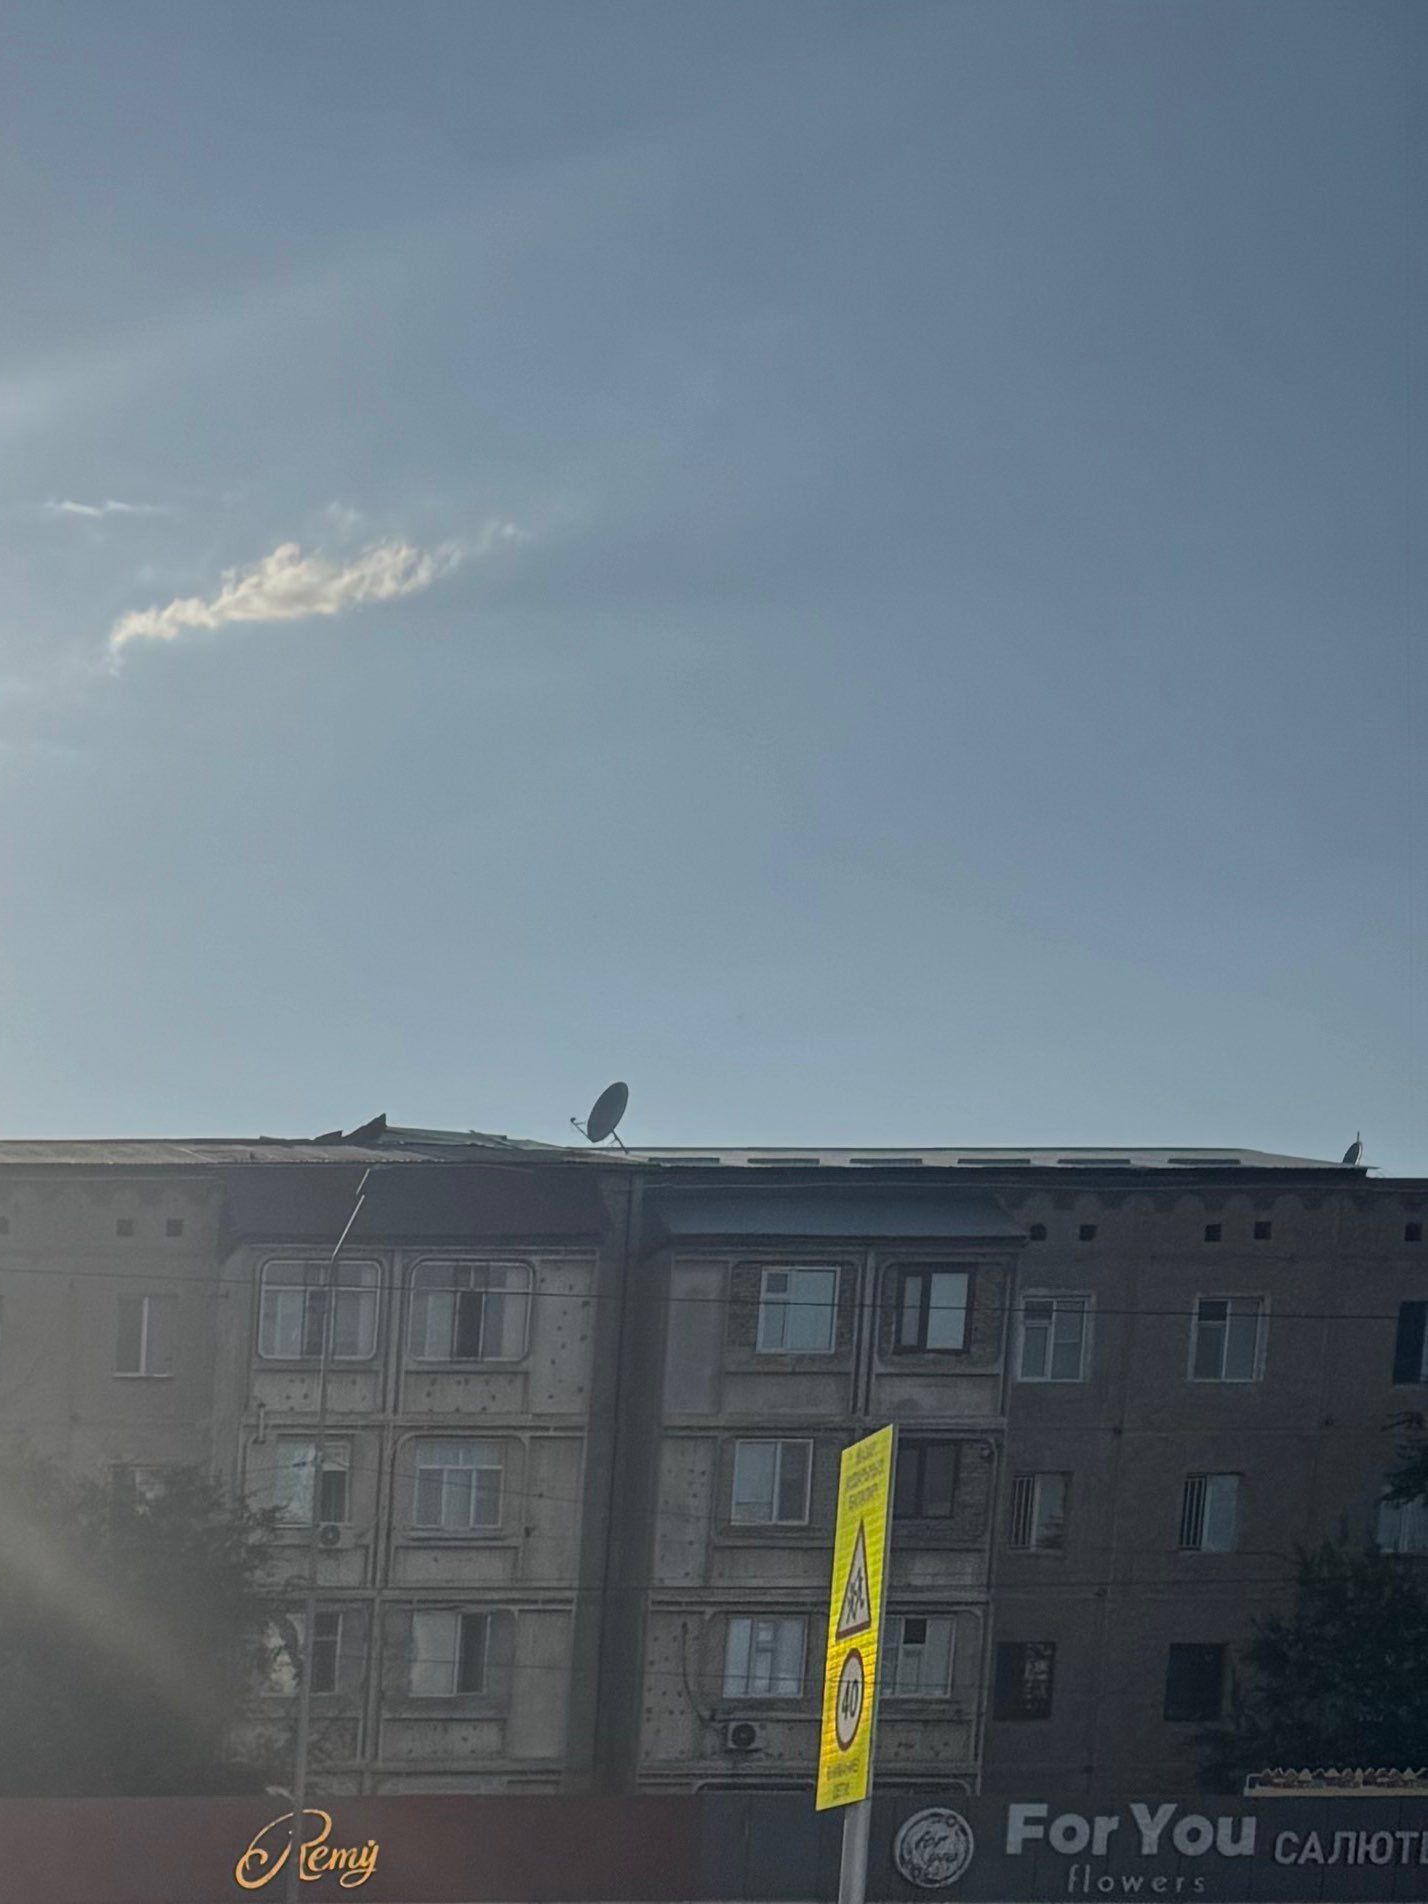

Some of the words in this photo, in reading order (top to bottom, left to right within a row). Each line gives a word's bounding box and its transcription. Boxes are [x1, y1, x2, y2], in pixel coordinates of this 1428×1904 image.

[842, 1679, 859, 1720] 40
[1006, 1803, 1119, 1857] For
[1130, 1803, 1257, 1857] You
[1068, 1864, 1206, 1894] flowers
